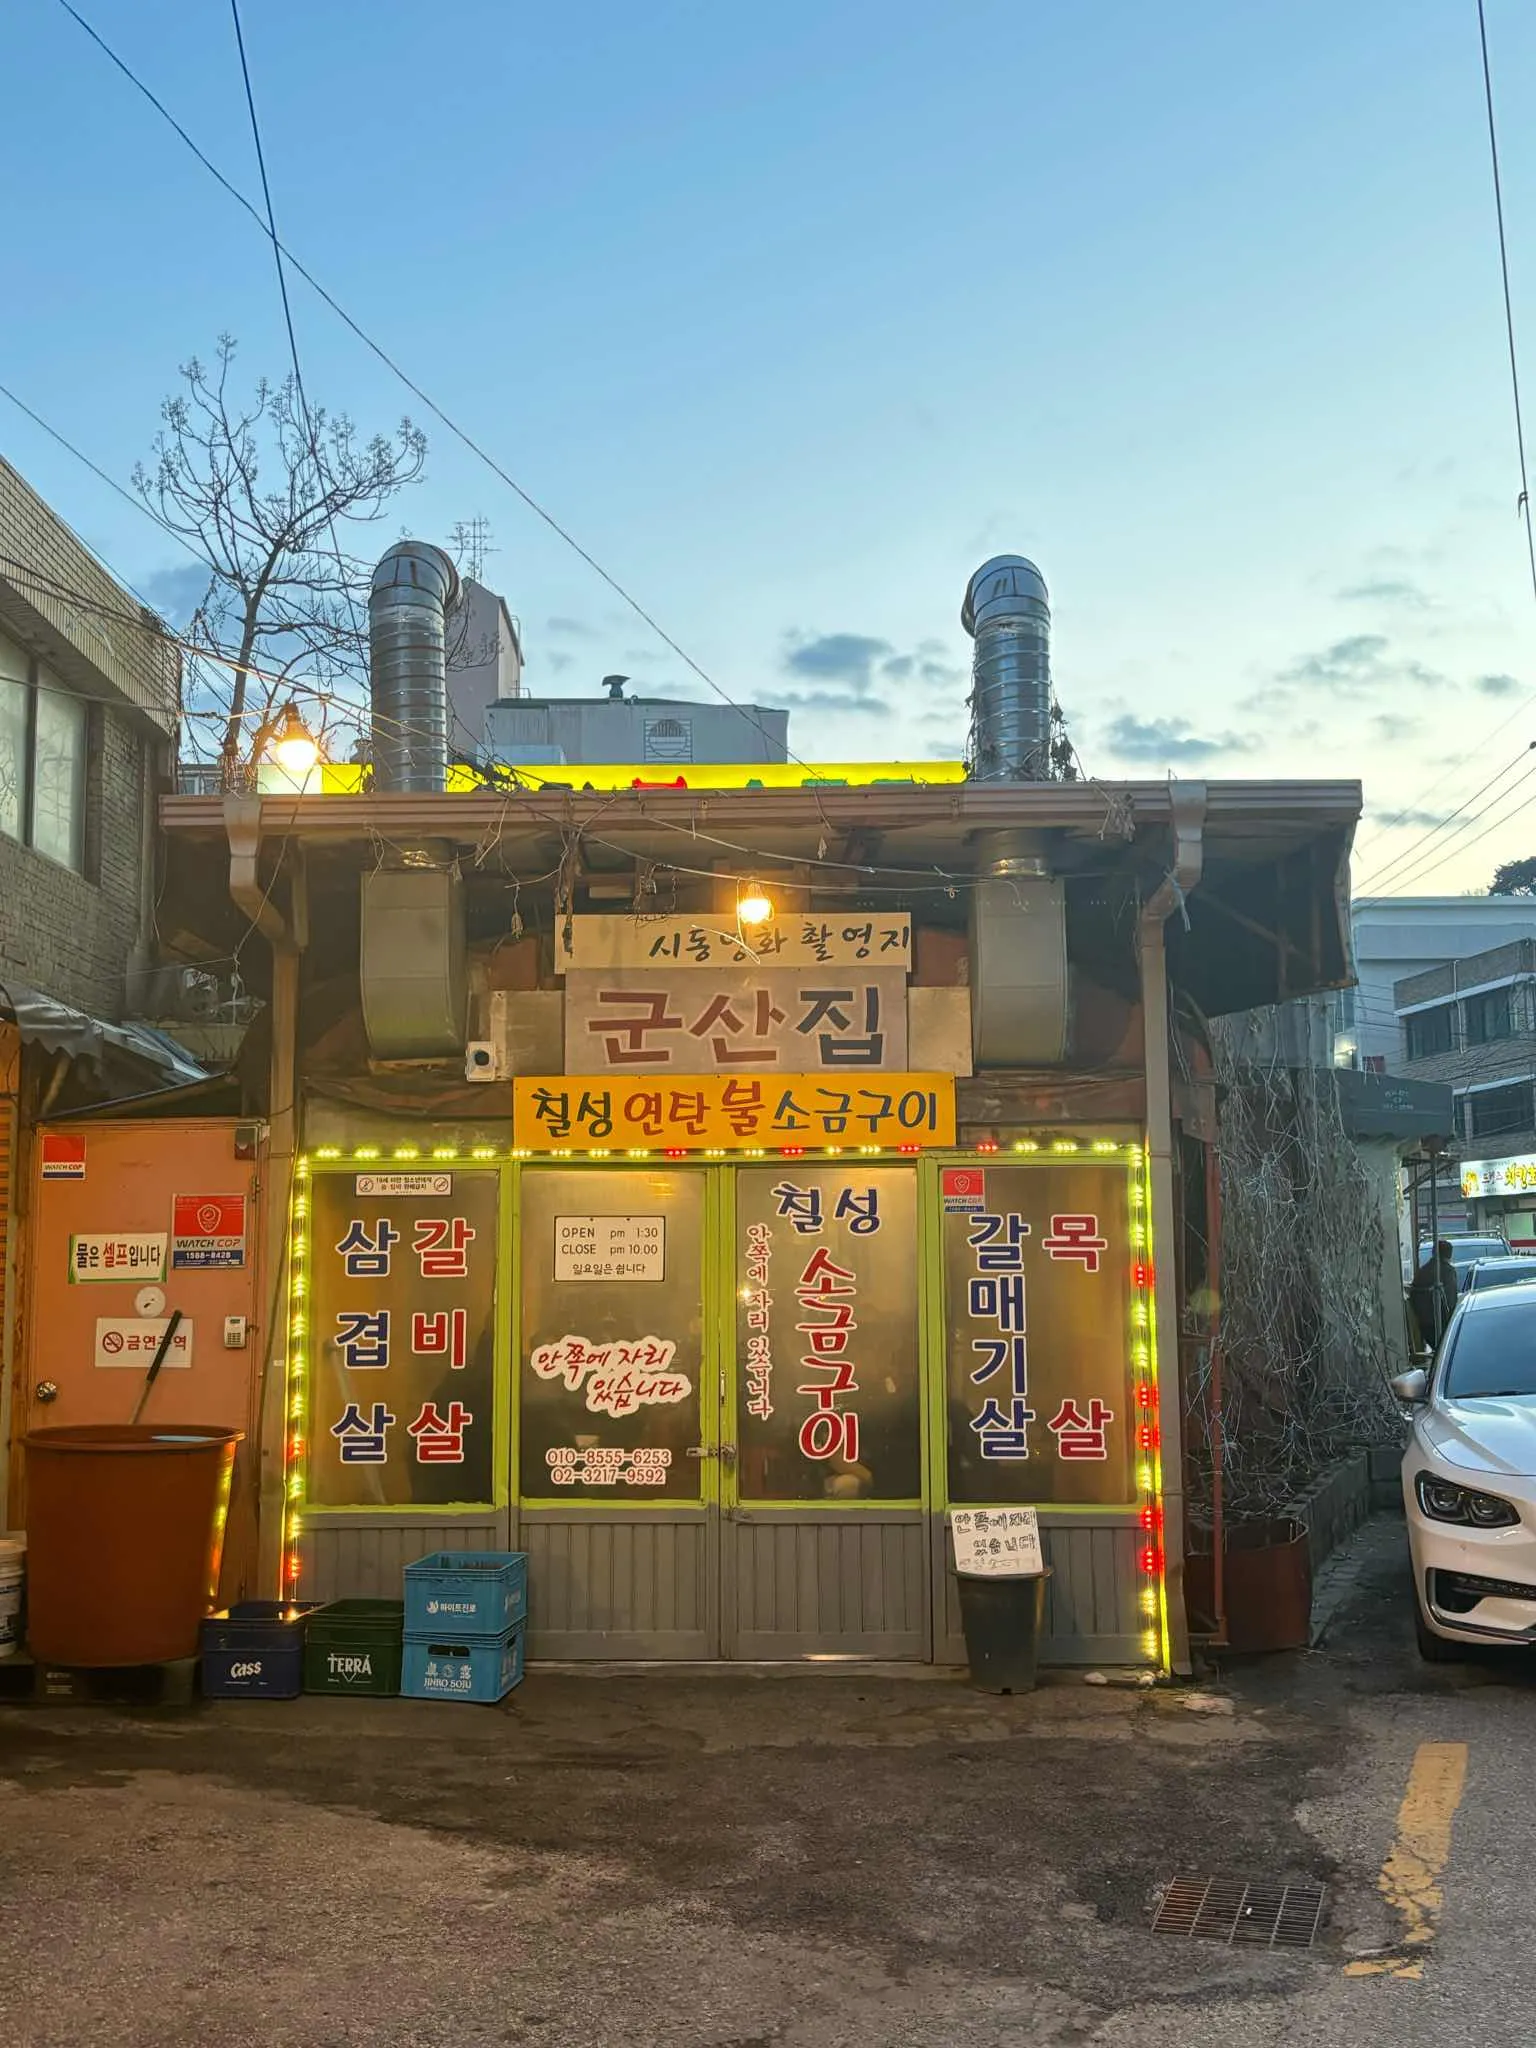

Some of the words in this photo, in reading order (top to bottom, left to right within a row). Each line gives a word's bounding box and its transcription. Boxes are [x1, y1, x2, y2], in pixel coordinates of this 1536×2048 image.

[801, 922, 910, 962] 촬영지
[588, 986, 884, 1065] 군산집
[531, 1087, 613, 1138] 칠성
[770, 1087, 937, 1134] 소금구이
[773, 1183, 881, 1234] 칠성
[176, 1239, 214, 1248] WATCH
[217, 1239, 241, 1248] COP
[562, 1227, 595, 1238] OPEN
[610, 1229, 625, 1240] pm
[562, 1244, 597, 1255] CLOSE
[610, 1246, 625, 1256] pm
[76, 1243, 100, 1269] 물은
[103, 1242, 160, 1269] 셀프입니다
[573, 1263, 613, 1275] 일요일은
[615, 1263, 647, 1275] 쉽니다
[538, 1343, 612, 1383] 안쪽에
[618, 1344, 668, 1366] 자리
[796, 1248, 858, 1462] 소금구이
[593, 1371, 683, 1410] 있습니다
[231, 1661, 262, 1678] Cass
[327, 1654, 373, 1675] TERRA
